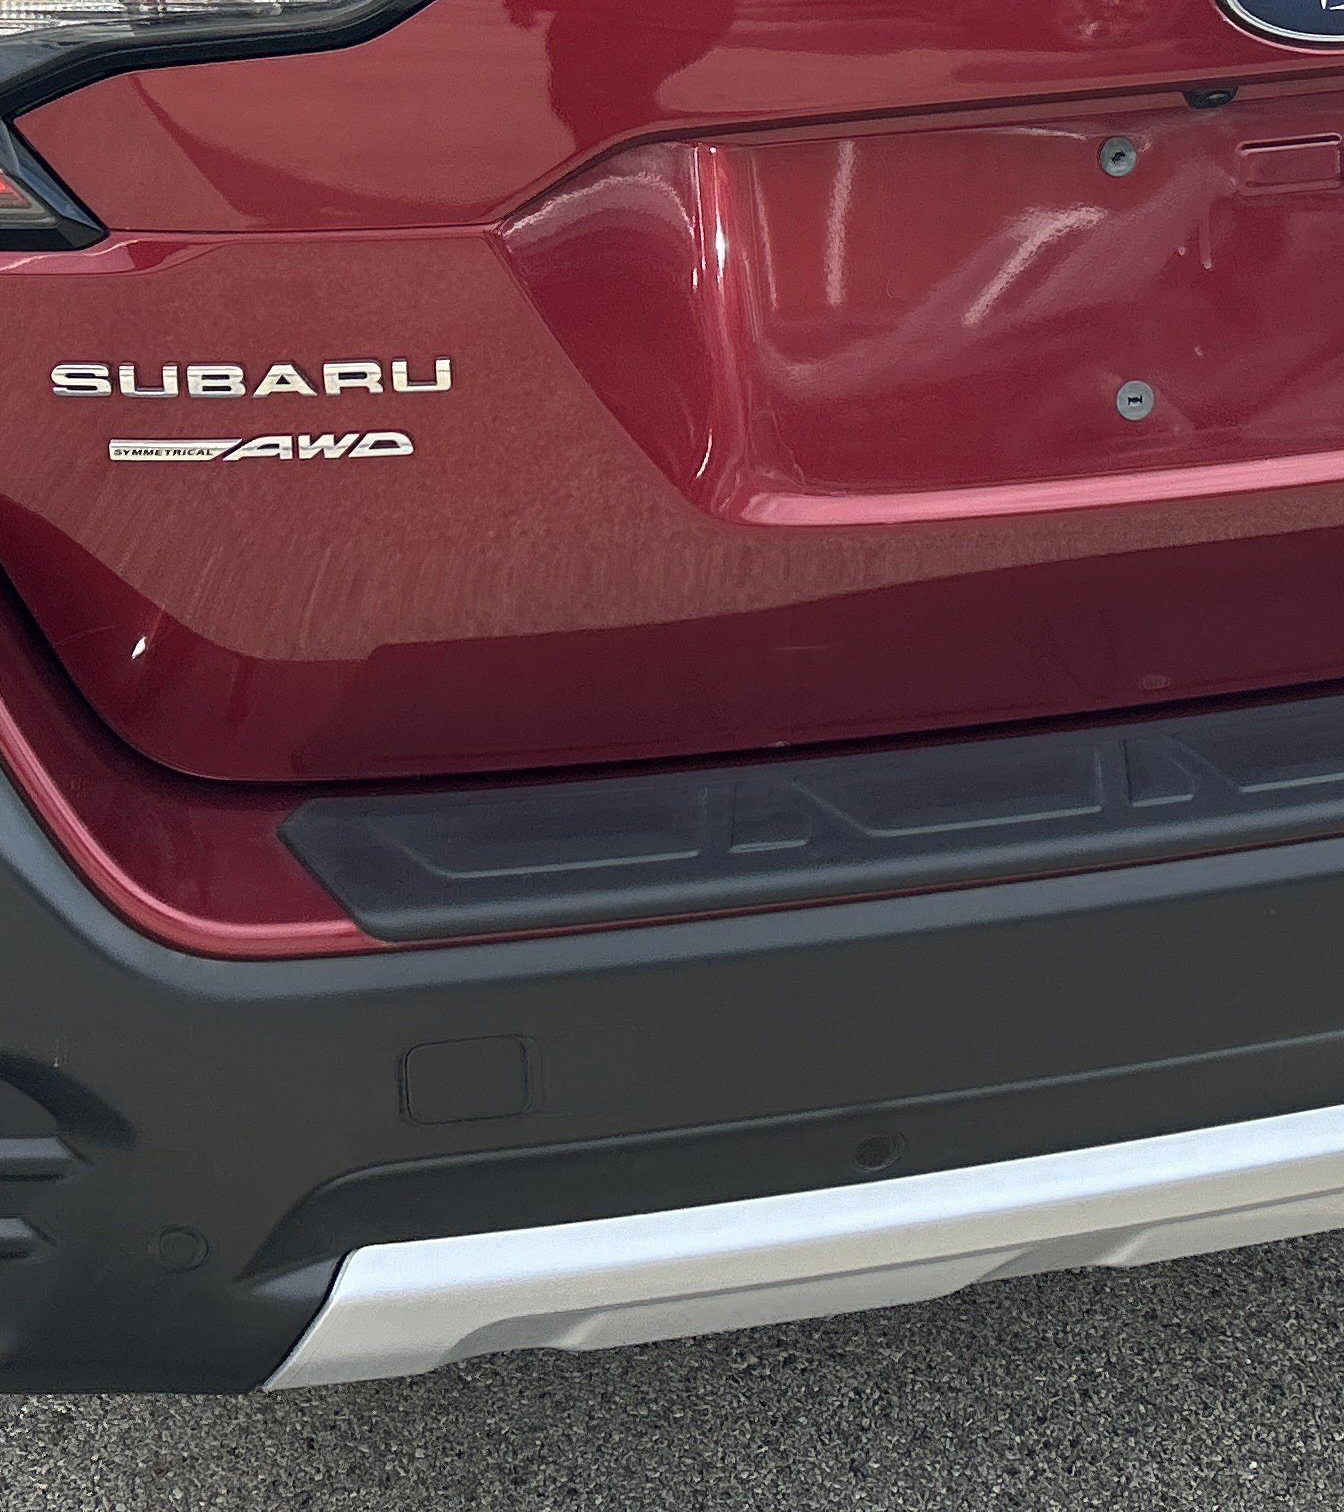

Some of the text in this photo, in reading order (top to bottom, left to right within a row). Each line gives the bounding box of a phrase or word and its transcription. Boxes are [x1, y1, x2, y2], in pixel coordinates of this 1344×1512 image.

[50, 358, 452, 399] SUBARU
[112, 430, 415, 462] SYMMETRICAL AWD
